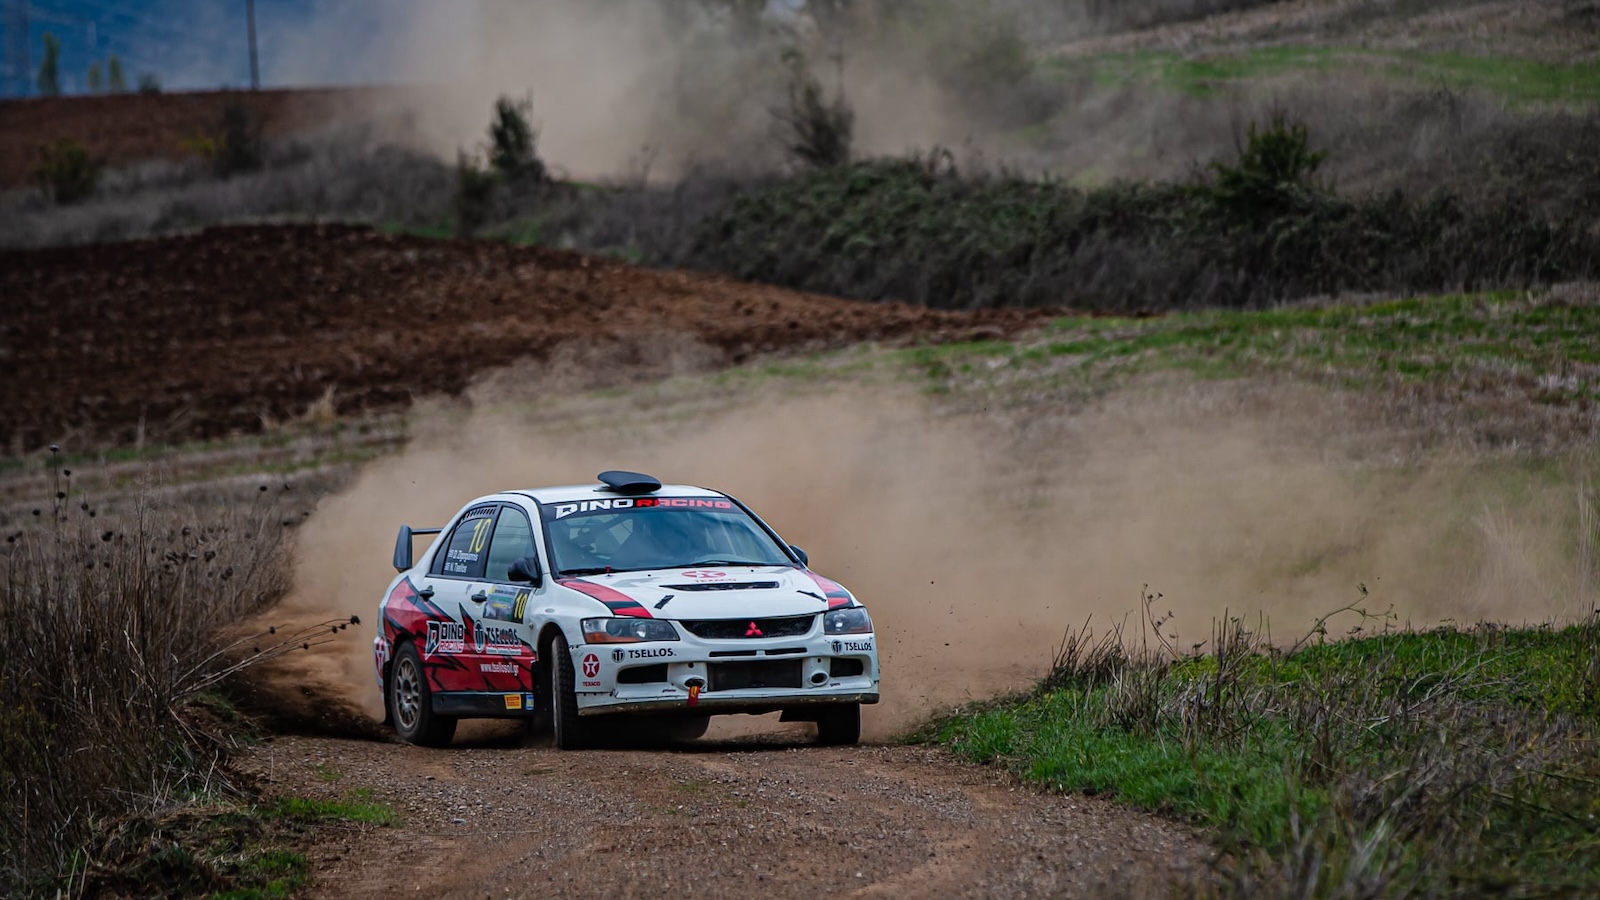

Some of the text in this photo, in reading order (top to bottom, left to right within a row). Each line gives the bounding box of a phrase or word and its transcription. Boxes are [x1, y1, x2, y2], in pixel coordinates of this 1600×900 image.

[554, 498, 731, 519] DINO RACING
[469, 518, 492, 553] 10
[513, 593, 528, 619] 10
[440, 623, 464, 640] DINO
